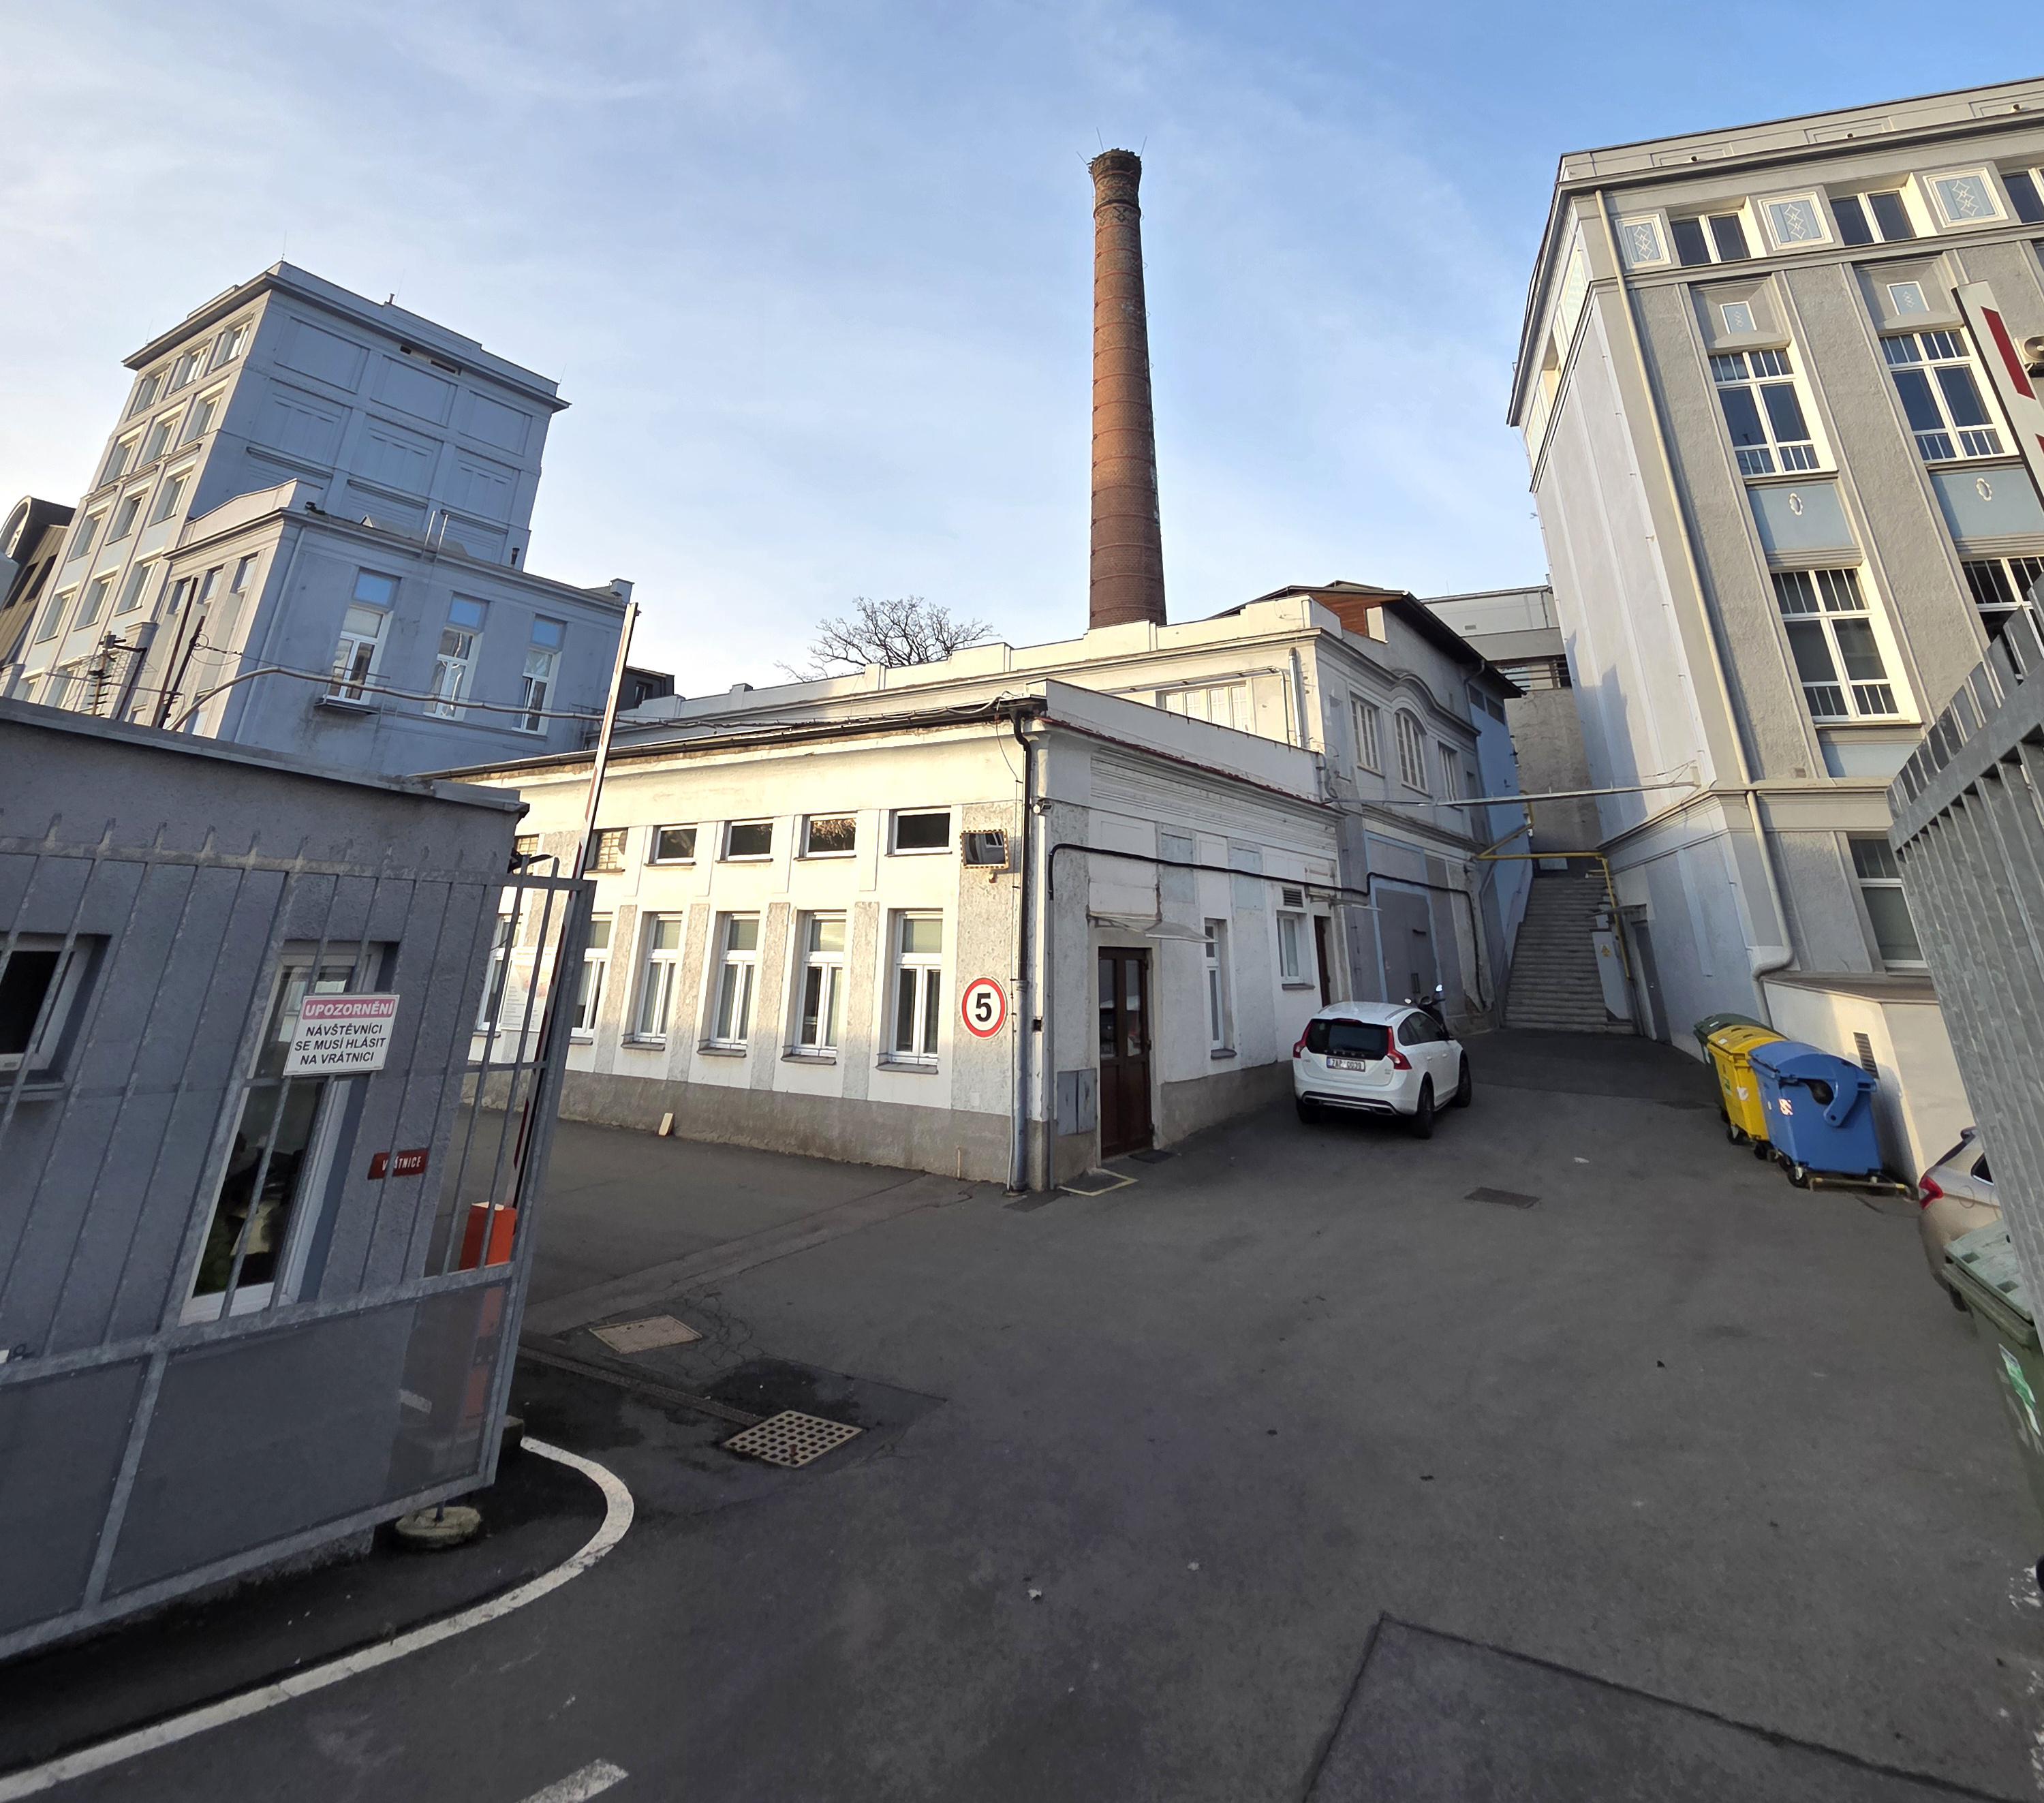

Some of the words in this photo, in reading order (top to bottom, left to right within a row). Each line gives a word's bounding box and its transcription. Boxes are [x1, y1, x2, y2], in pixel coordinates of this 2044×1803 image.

[305, 1000, 394, 1016] UPOZORNĚNÍ
[975, 992, 992, 1022] 5
[305, 1022, 383, 1036] NÁVŠTĚVNÍCI
[294, 1041, 311, 1051] SE
[313, 1037, 344, 1050] MUSÍ
[345, 1036, 386, 1049] HLÁSIT
[300, 1055, 317, 1066] NA
[321, 1051, 374, 1064] VRÁTNICI
[382, 1156, 422, 1171] VÁTNICE
